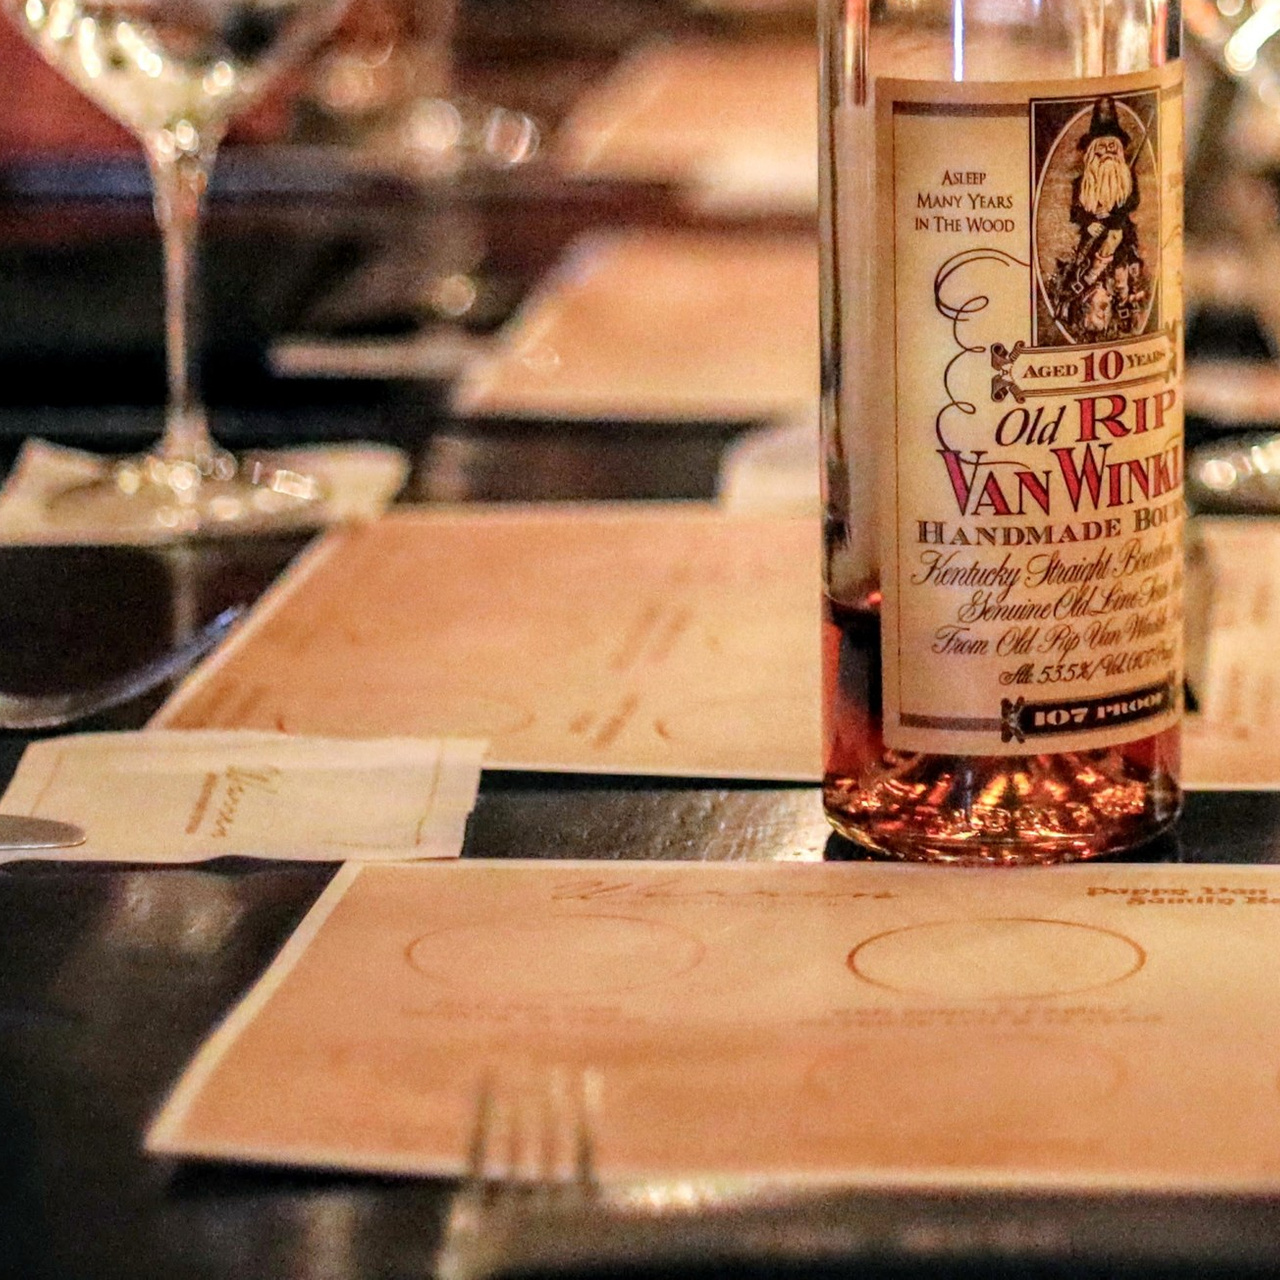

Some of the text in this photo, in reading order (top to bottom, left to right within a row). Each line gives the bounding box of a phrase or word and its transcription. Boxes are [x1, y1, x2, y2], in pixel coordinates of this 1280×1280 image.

[941, 170, 986, 186] ASLEEP
[917, 193, 1013, 210] MANY YEARS
[915, 216, 1015, 233] IN THE WOOD
[1022, 349, 1166, 383] AGED 10 YEARS
[995, 389, 1176, 446] Old RIP
[936, 449, 1052, 517] VAN
[916, 518, 1122, 546] HANDMADE
[911, 549, 1021, 603] Kentucky
[1024, 546, 1113, 588] Straight
[958, 589, 1053, 623] Genuine
[1053, 584, 1097, 620] Old
[931, 625, 990, 655] From
[996, 626, 1040, 656] Old
[1038, 623, 1080, 663] Rip
[1034, 707, 1088, 726] 107
